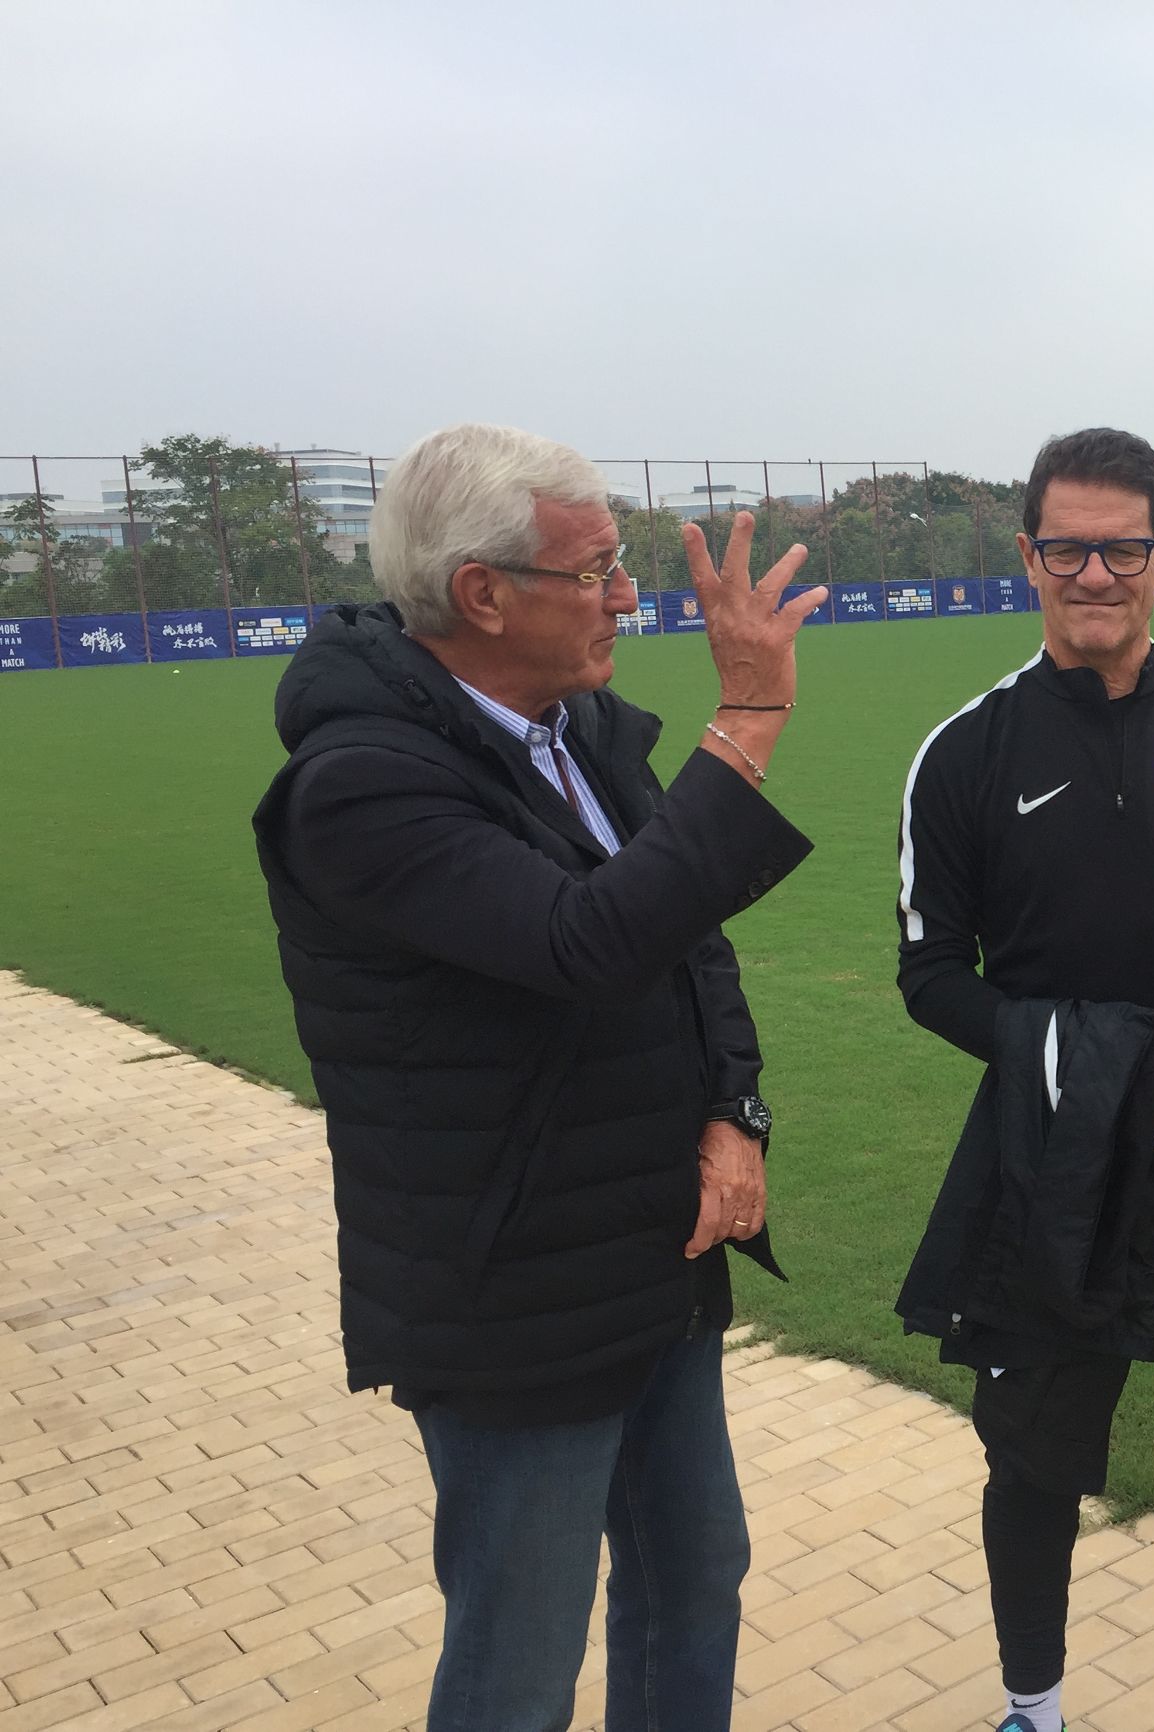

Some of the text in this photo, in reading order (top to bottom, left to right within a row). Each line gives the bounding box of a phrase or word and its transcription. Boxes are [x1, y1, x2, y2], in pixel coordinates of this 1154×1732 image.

[0, 624, 20, 635] MORE
[9, 648, 15, 656] A
[1, 658, 25, 667] MATCH
